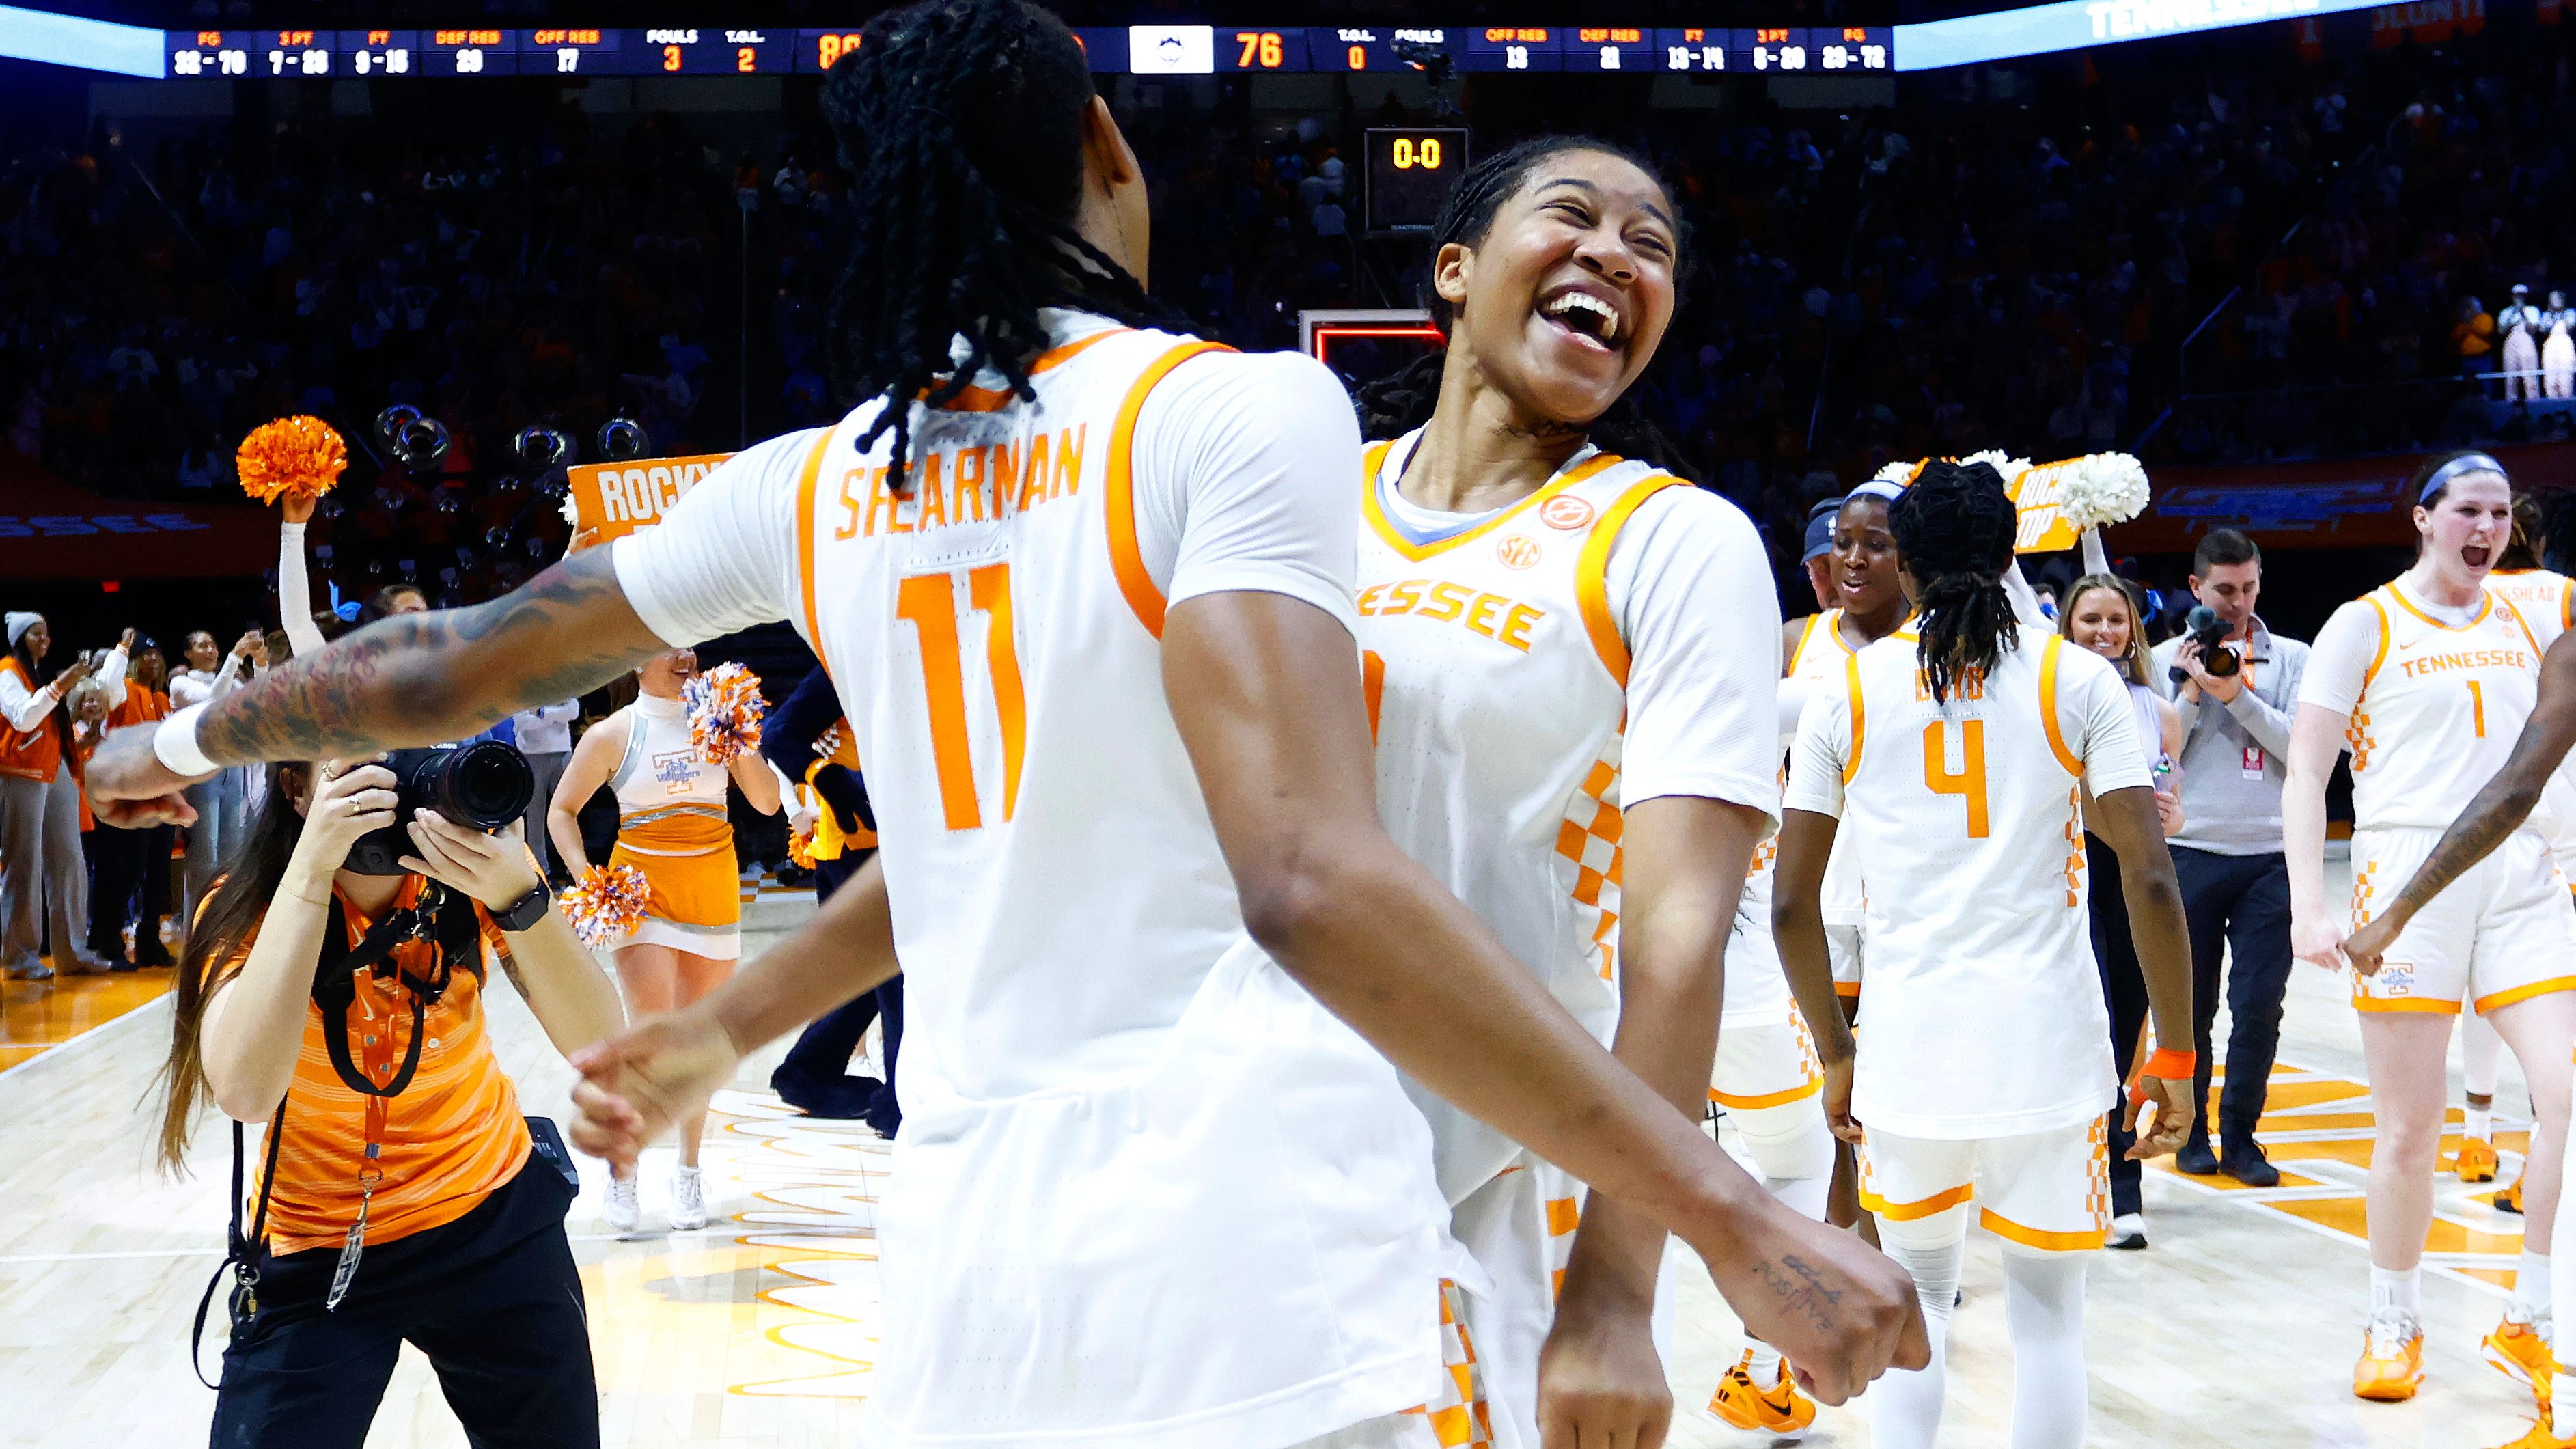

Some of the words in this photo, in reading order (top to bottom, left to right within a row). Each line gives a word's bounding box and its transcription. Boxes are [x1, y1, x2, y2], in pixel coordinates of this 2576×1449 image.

[197, 31, 221, 46] FG
[368, 31, 390, 44] FT
[534, 30, 567, 44] OFF
[646, 29, 698, 43] FOULS
[1394, 29, 1444, 43] FOULS
[1486, 29, 1515, 42] OFF
[1685, 29, 1705, 42] FT
[1844, 28, 1866, 42] FG
[557, 48, 579, 72] 17
[663, 46, 682, 72] 3
[738, 47, 756, 72] 2
[1236, 32, 1283, 68] 76
[1348, 46, 1366, 70] 0
[1506, 46, 1528, 69] 13
[835, 422, 1088, 540] SPEARMAN
[2400, 650, 2526, 678] TENNESSEE
[1915, 666, 1984, 702] BYD
[896, 562, 1027, 831] 11
[2467, 680, 2486, 739] 1
[1923, 719, 1991, 839] 4
